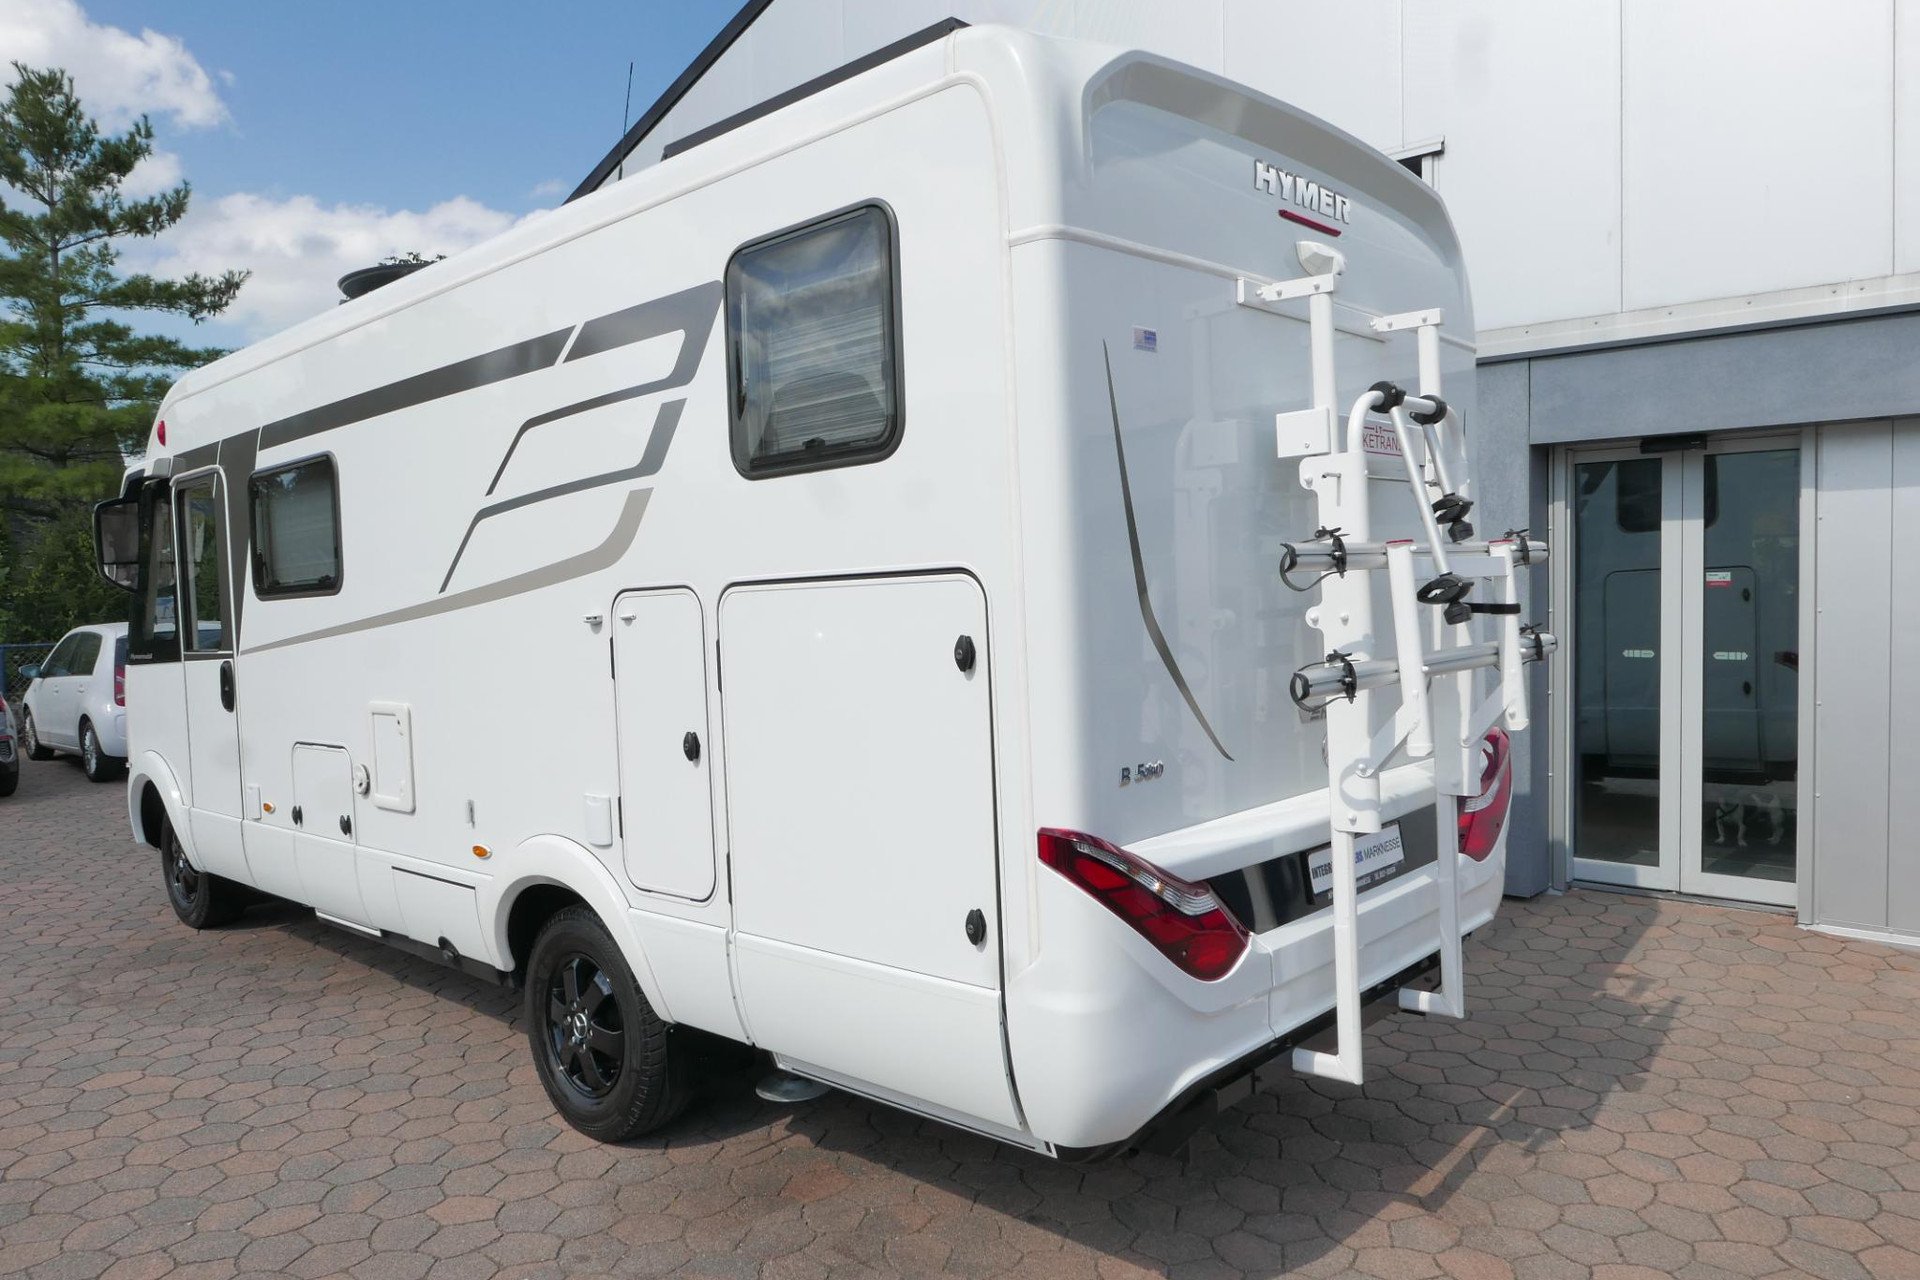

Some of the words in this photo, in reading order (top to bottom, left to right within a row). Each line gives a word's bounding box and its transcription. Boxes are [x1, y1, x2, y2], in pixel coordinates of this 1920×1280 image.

[1254, 159, 1350, 225] HYMER
[1362, 431, 1402, 451] KETRAN
[1120, 767, 1131, 786] B
[1311, 860, 1333, 879] INTEGR
[1363, 836, 1400, 860] MARKNESSE
